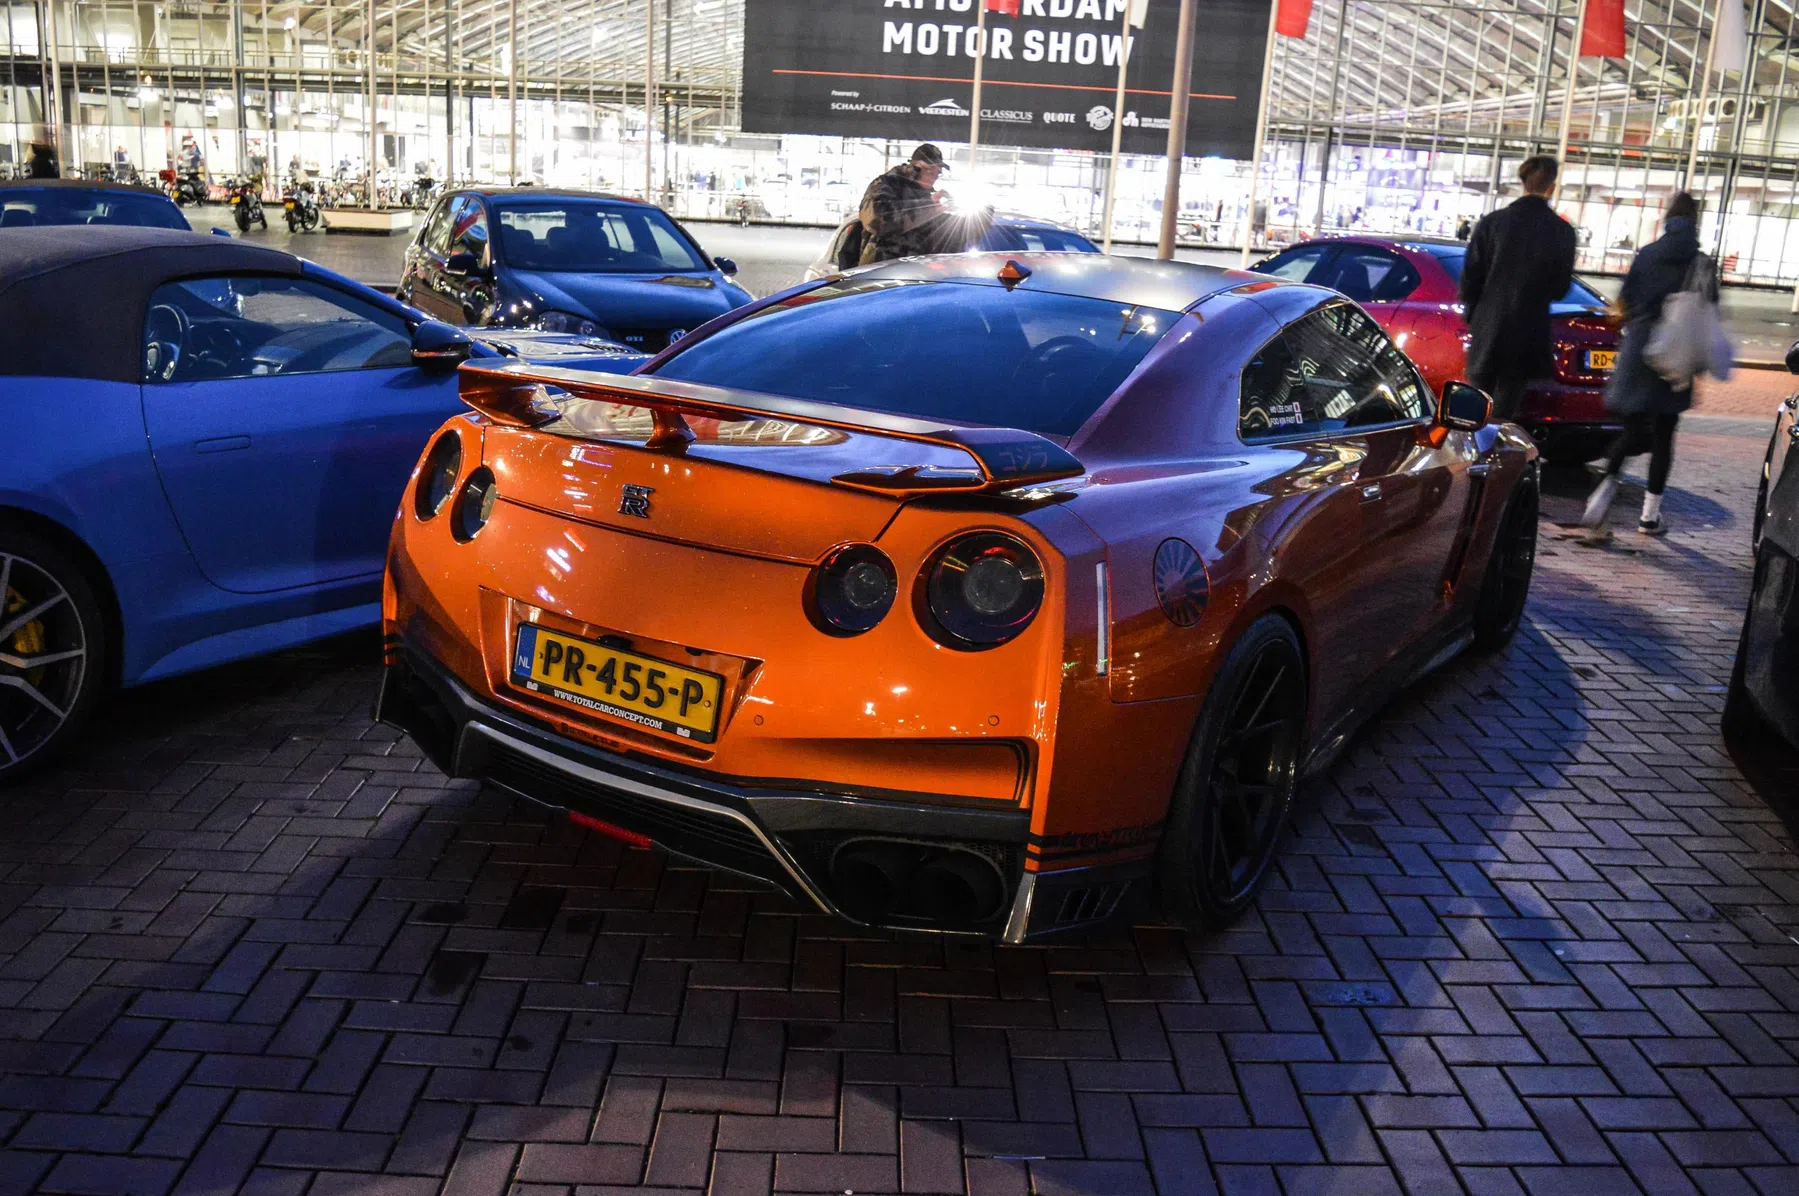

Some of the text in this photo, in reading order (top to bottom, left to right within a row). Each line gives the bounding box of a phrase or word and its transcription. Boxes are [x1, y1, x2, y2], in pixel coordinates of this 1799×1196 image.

[883, 21, 1135, 66] MOTOR SHOW
[980, 108, 1033, 120] CLASSICUS
[1043, 112, 1076, 123] QUOTE
[518, 639, 704, 717] NL PR-455-P
[554, 689, 663, 730] WWW.TOTALCARCONCEPT.COM
